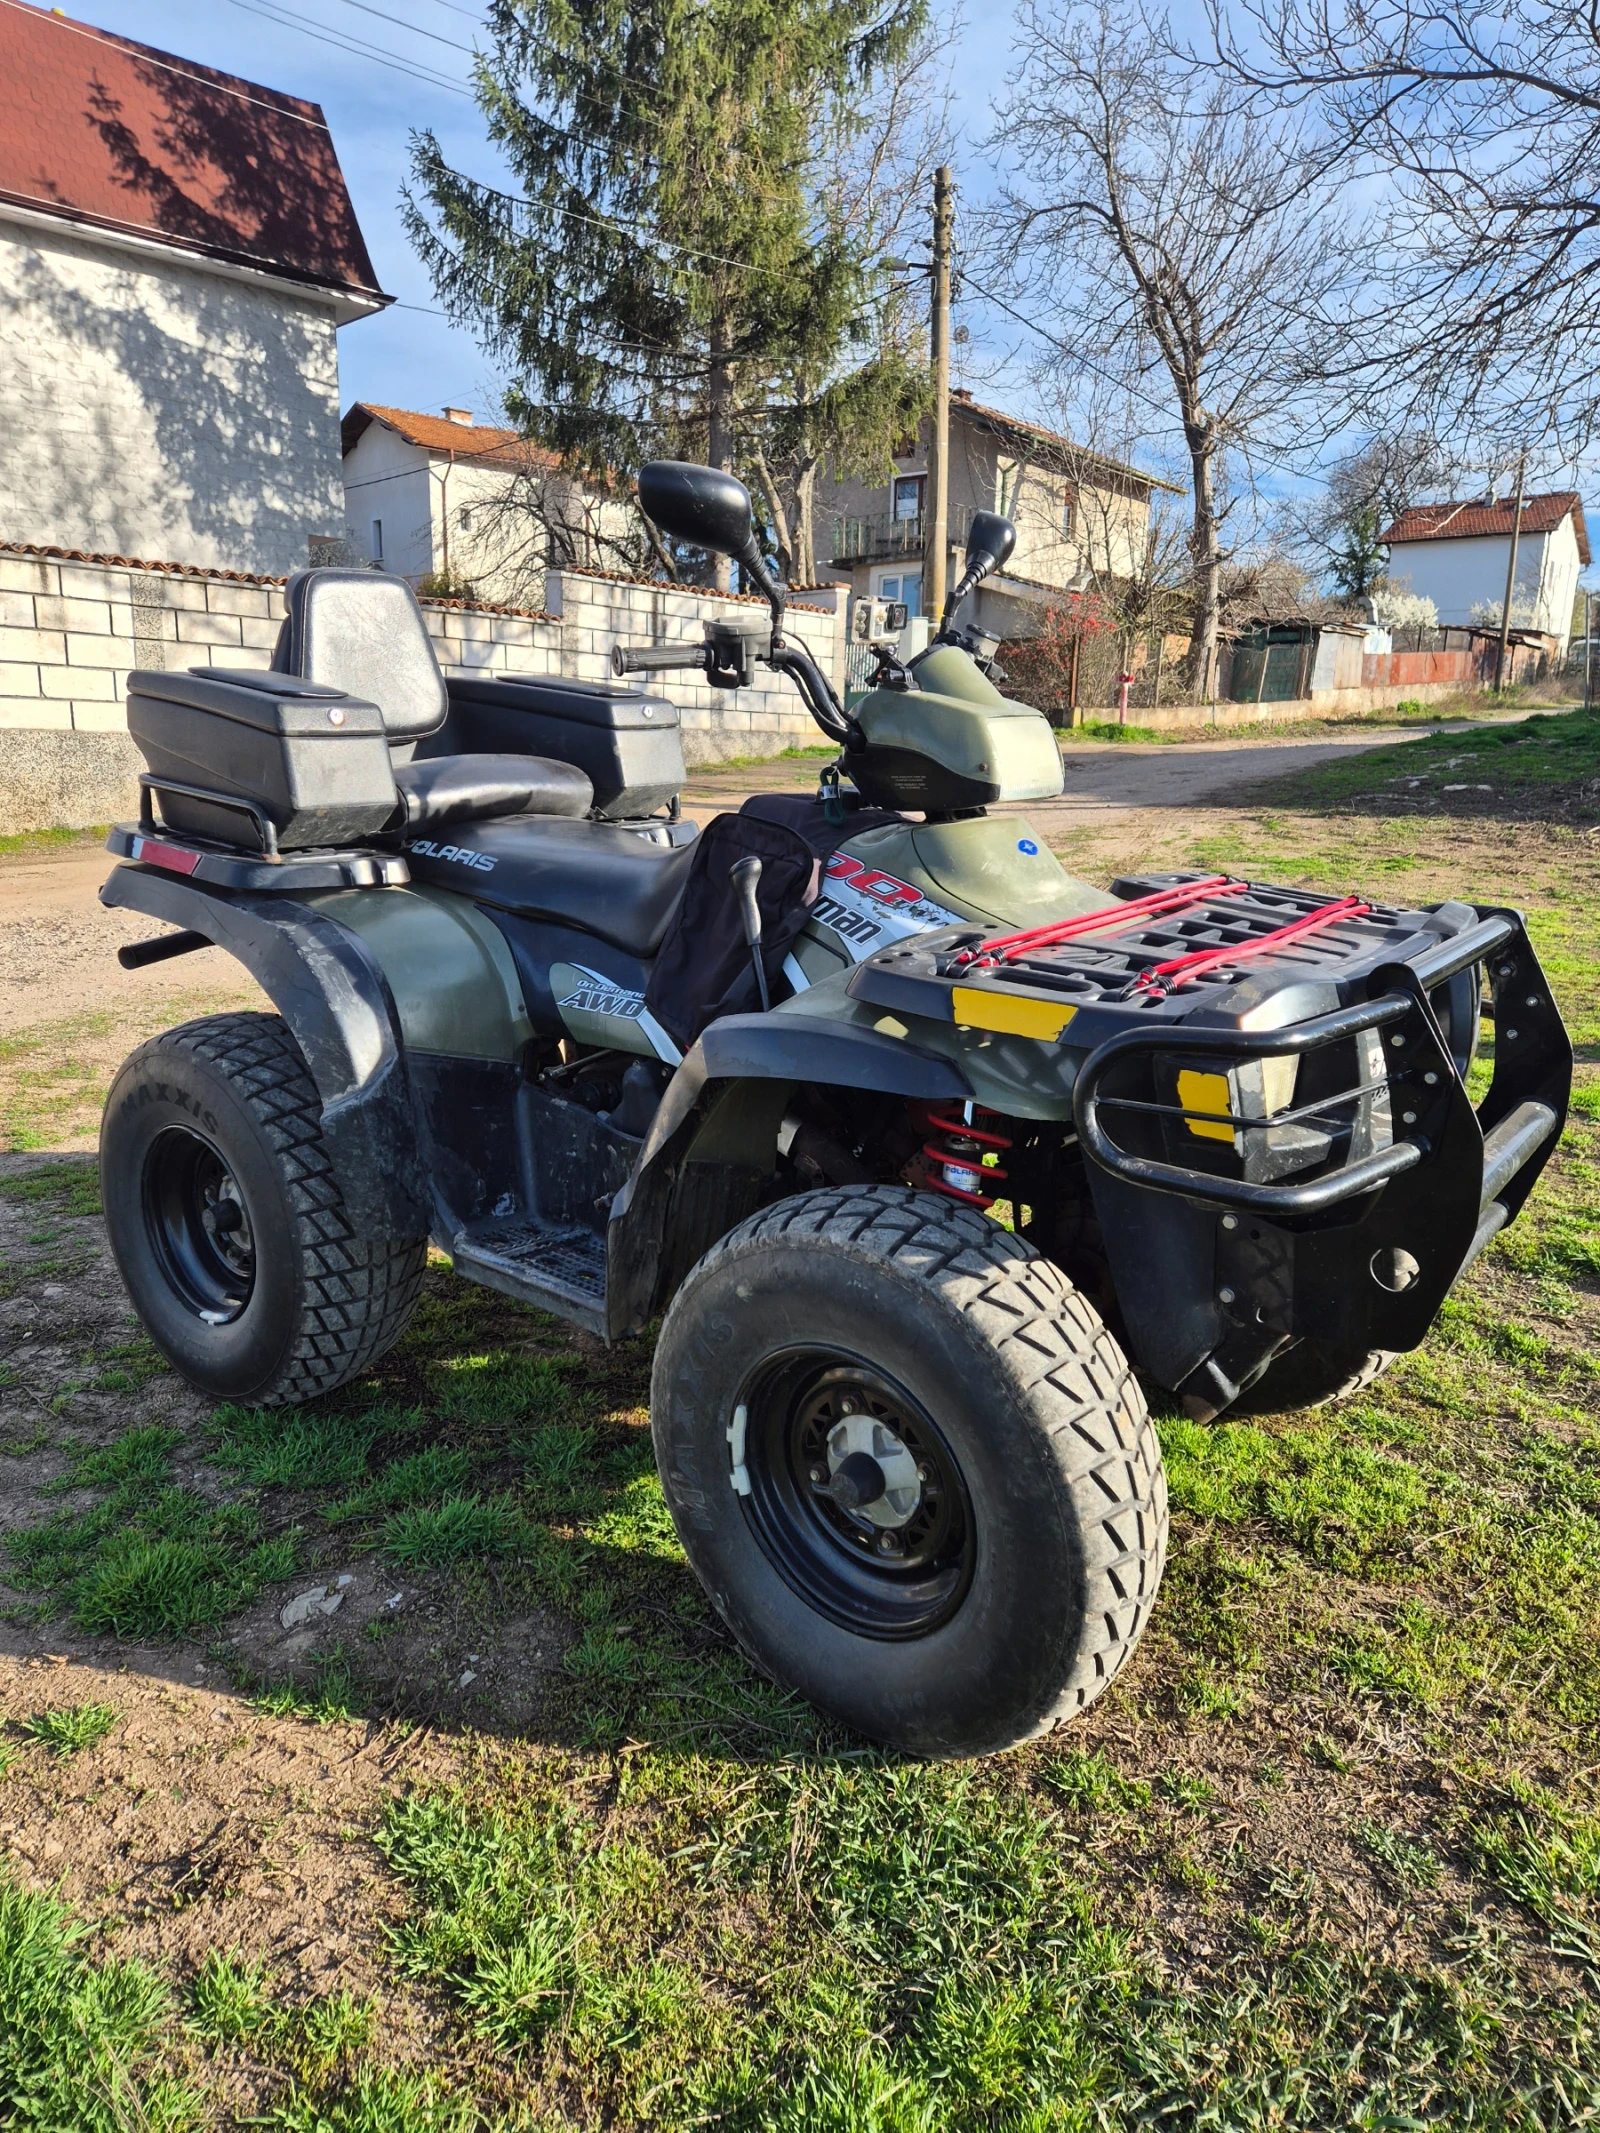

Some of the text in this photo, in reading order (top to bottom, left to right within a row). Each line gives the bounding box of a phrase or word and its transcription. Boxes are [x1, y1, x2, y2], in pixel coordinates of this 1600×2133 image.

[576, 979, 594, 990] On
[556, 988, 648, 1020] AWD
[120, 1082, 219, 1136] MAXXIS
